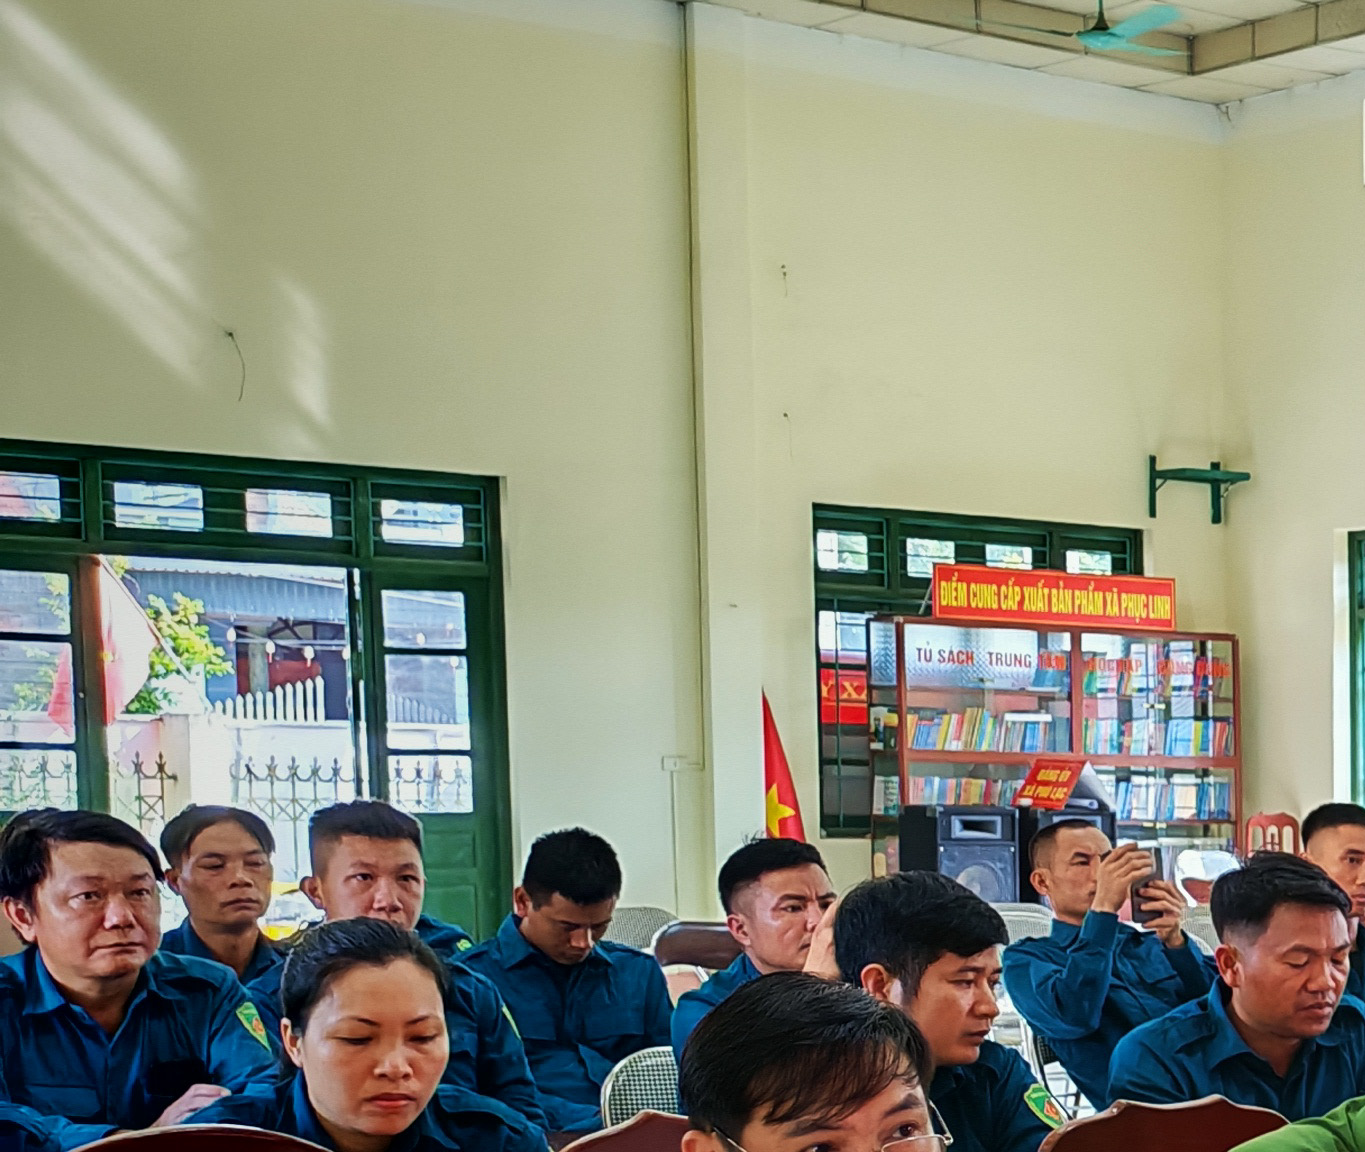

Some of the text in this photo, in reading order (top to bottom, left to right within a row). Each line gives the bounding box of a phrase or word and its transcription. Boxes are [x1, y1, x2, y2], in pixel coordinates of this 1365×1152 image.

[940, 571, 1171, 624] ĐIỂM CUNG CẤP XUẤT BẢN PHẨM XÃ PHỤC LINH
[916, 641, 933, 663] TỦ
[937, 646, 974, 667] SÁCH
[987, 651, 1032, 669] TRUNG
